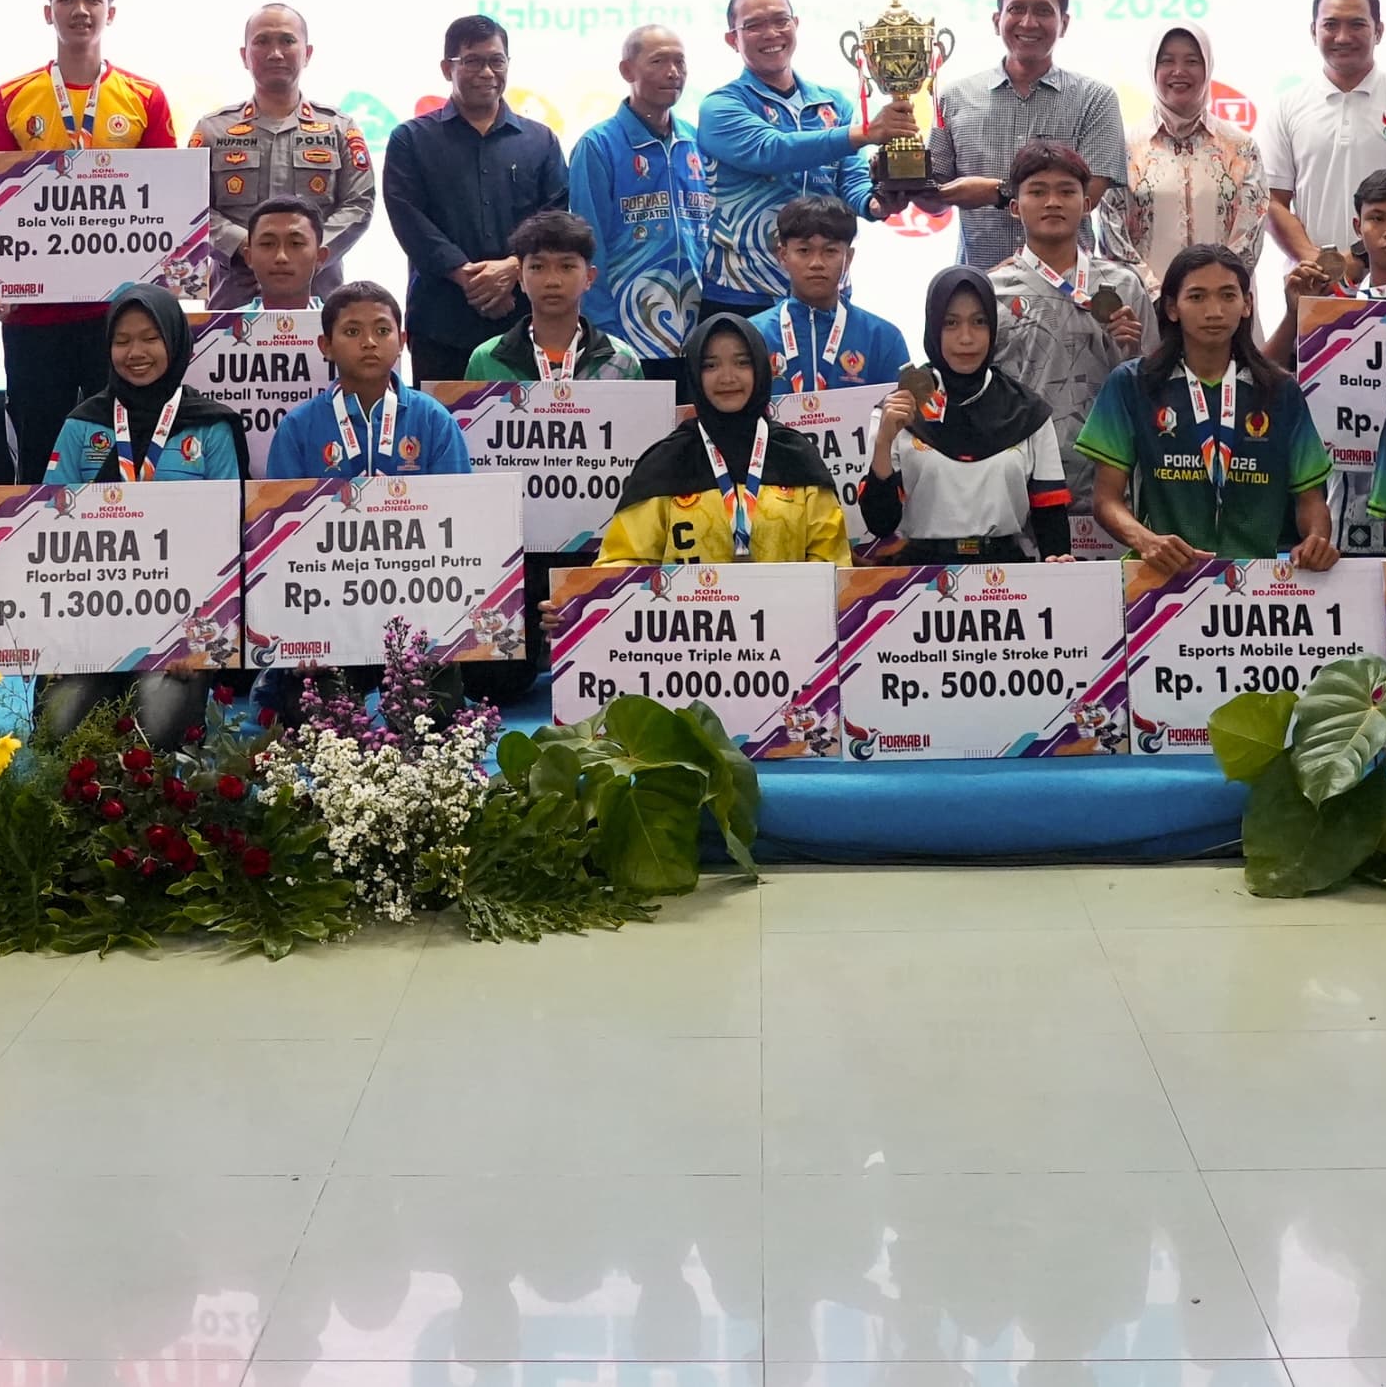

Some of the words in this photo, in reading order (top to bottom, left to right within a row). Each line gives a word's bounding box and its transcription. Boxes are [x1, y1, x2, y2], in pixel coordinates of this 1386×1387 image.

[295, 136, 335, 146] POLRI
[34, 184, 126, 212] JUARA
[138, 184, 149, 208] 1
[18, 217, 46, 228] Bola
[50, 216, 75, 226] Voli
[79, 216, 125, 228] Beregu
[130, 214, 164, 225] Putra
[0, 235, 37, 262] Rp.
[47, 232, 173, 255] 2.000.000
[1340, 375, 1381, 389] Balap
[487, 420, 586, 450] JUARA
[599, 421, 612, 449] 1
[495, 455, 539, 467] Takraw
[544, 456, 571, 467] Inter
[584, 456, 606, 469] Regu
[317, 518, 426, 553] JUARA
[438, 518, 453, 548] 1
[28, 530, 140, 564] JUARA
[154, 529, 168, 560] 1
[288, 560, 327, 573] Tenis
[332, 559, 369, 574] Meja
[374, 556, 436, 572] Tunggal
[441, 555, 481, 567] Putra
[26, 569, 91, 583] Floorbal
[96, 569, 126, 581] 3V3
[133, 568, 168, 580] Putri
[285, 582, 330, 614] Rp.
[343, 576, 485, 607] 500.000,-
[625, 610, 737, 642] JUARA
[750, 610, 764, 641] 1
[913, 608, 1025, 643] JUARA
[1038, 607, 1053, 639] 1
[609, 649, 682, 663] Petanque
[688, 649, 732, 664] Triple
[737, 650, 764, 661] Mix
[769, 650, 780, 661] A
[878, 650, 946, 663] Woodball
[952, 648, 997, 663] Single
[1003, 648, 1049, 661] Stroke
[1053, 646, 1087, 659] Putri
[1179, 645, 1235, 658] Esports
[1240, 644, 1293, 656] Mobile
[1299, 643, 1363, 658] Legends
[881, 673, 929, 706] Rp.
[941, 669, 1087, 699] 500.000,-
[879, 735, 922, 748] PORKAB
